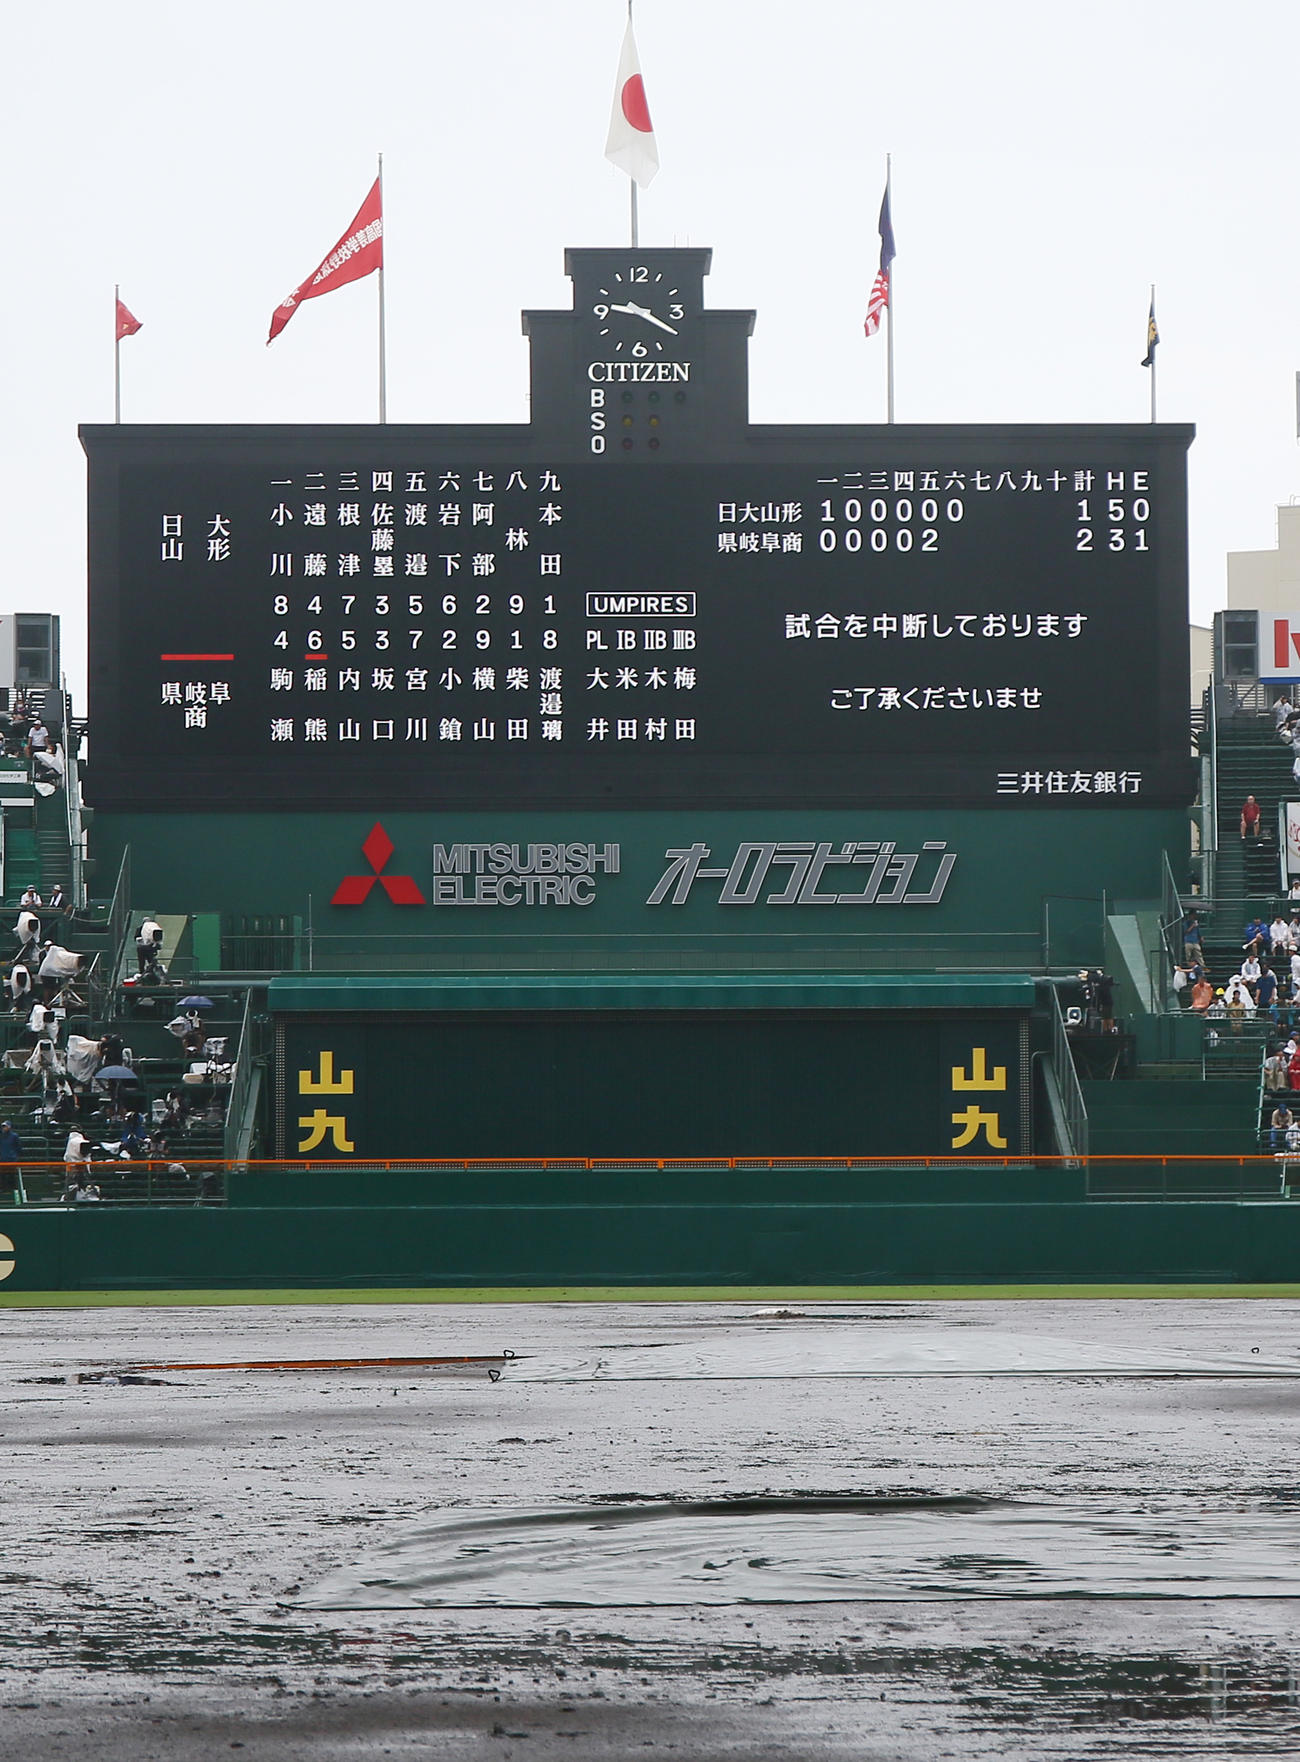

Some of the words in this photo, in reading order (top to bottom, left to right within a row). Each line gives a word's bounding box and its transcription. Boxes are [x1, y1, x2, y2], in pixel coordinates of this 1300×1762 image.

[630, 267, 648, 282] 12
[594, 305, 608, 319] 9
[670, 305, 683, 319] 3
[632, 342, 647, 357] 6
[588, 363, 690, 381] CITIZEN
[591, 389, 604, 407] B
[591, 412, 605, 430] S
[719, 503, 802, 522] 日大山形
[506, 528, 528, 550] 林
[718, 532, 802, 553] 県岐阜商
[275, 596, 288, 614] 8
[308, 596, 322, 614] 4
[342, 596, 355, 614] 7
[376, 596, 389, 614] 3
[409, 596, 422, 614] 5
[443, 595, 456, 614] 6
[476, 595, 489, 613] 2
[510, 595, 523, 614] 9
[545, 596, 556, 613] 1
[595, 597, 687, 612] UMPIRES
[785, 613, 1087, 638] 試合を中断しております
[274, 631, 288, 649] 4
[308, 631, 321, 649] 6
[342, 631, 355, 649] 5
[376, 631, 389, 649] 3
[409, 631, 422, 649] 7
[443, 630, 456, 649] 2
[477, 630, 490, 649] 9
[512, 631, 522, 648] 1
[544, 630, 557, 649] 8
[587, 631, 608, 649] PL
[832, 687, 1042, 709] ご了承くださいませ
[997, 771, 1141, 793] 三井住友銀行
[433, 843, 620, 874] MITSUBISHI
[646, 841, 957, 905] オーロラビジョン
[433, 875, 596, 905] ELECTRIC
[299, 1052, 353, 1151] 山九
[952, 1048, 1006, 1148] 山九
